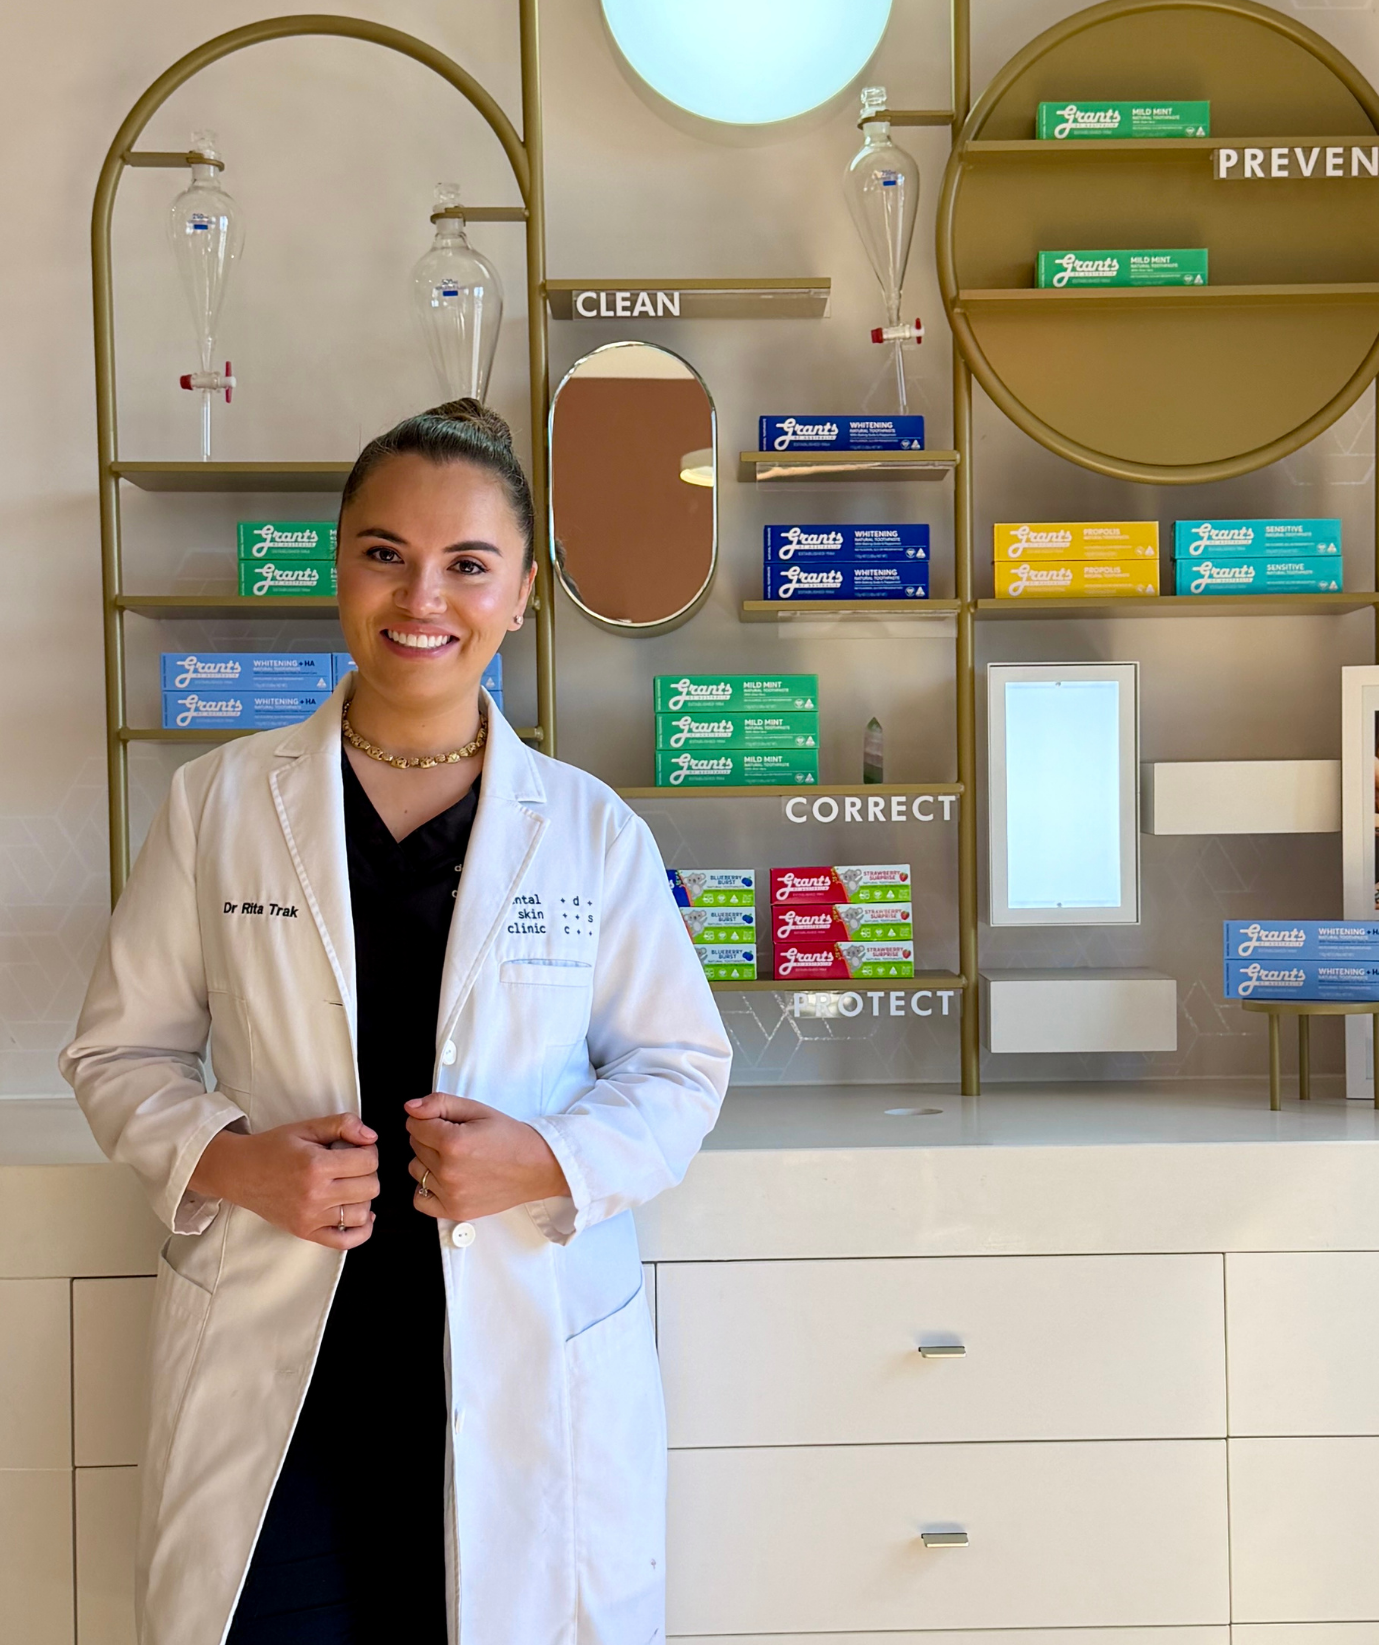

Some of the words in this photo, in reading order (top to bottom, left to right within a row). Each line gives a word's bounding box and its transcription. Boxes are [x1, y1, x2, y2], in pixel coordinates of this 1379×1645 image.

[1054, 104, 1121, 139] Grants
[1132, 108, 1151, 116] MILD
[1219, 147, 1379, 178] PREVEN
[1053, 253, 1119, 288] Grants
[576, 291, 680, 317] CLEAN
[774, 418, 839, 451] Grants
[252, 524, 318, 557] Grants
[778, 527, 844, 560] Grants
[1007, 525, 1072, 558] Grants
[1189, 523, 1254, 555] Grants
[253, 563, 319, 595] Grants
[778, 566, 843, 598] Grants
[1008, 563, 1073, 596] Grants
[1191, 561, 1255, 594] Grants
[175, 656, 241, 688] Grants
[176, 694, 243, 726] Grants
[668, 678, 732, 710] Grants
[670, 716, 734, 748] Grants
[669, 753, 733, 785] Grants
[785, 796, 955, 823] CORRECT
[512, 894, 541, 905] ntal
[776, 873, 831, 900] Grants
[223, 902, 238, 914] Dr
[241, 902, 264, 914] Rita
[269, 903, 299, 918] Trak
[518, 909, 544, 919] skin
[777, 911, 832, 938] Grants
[508, 922, 546, 934] clinic
[1238, 923, 1306, 957] Grants
[779, 948, 834, 975] Grants
[1238, 963, 1306, 996] Grants
[794, 991, 954, 1017] PROTECT
